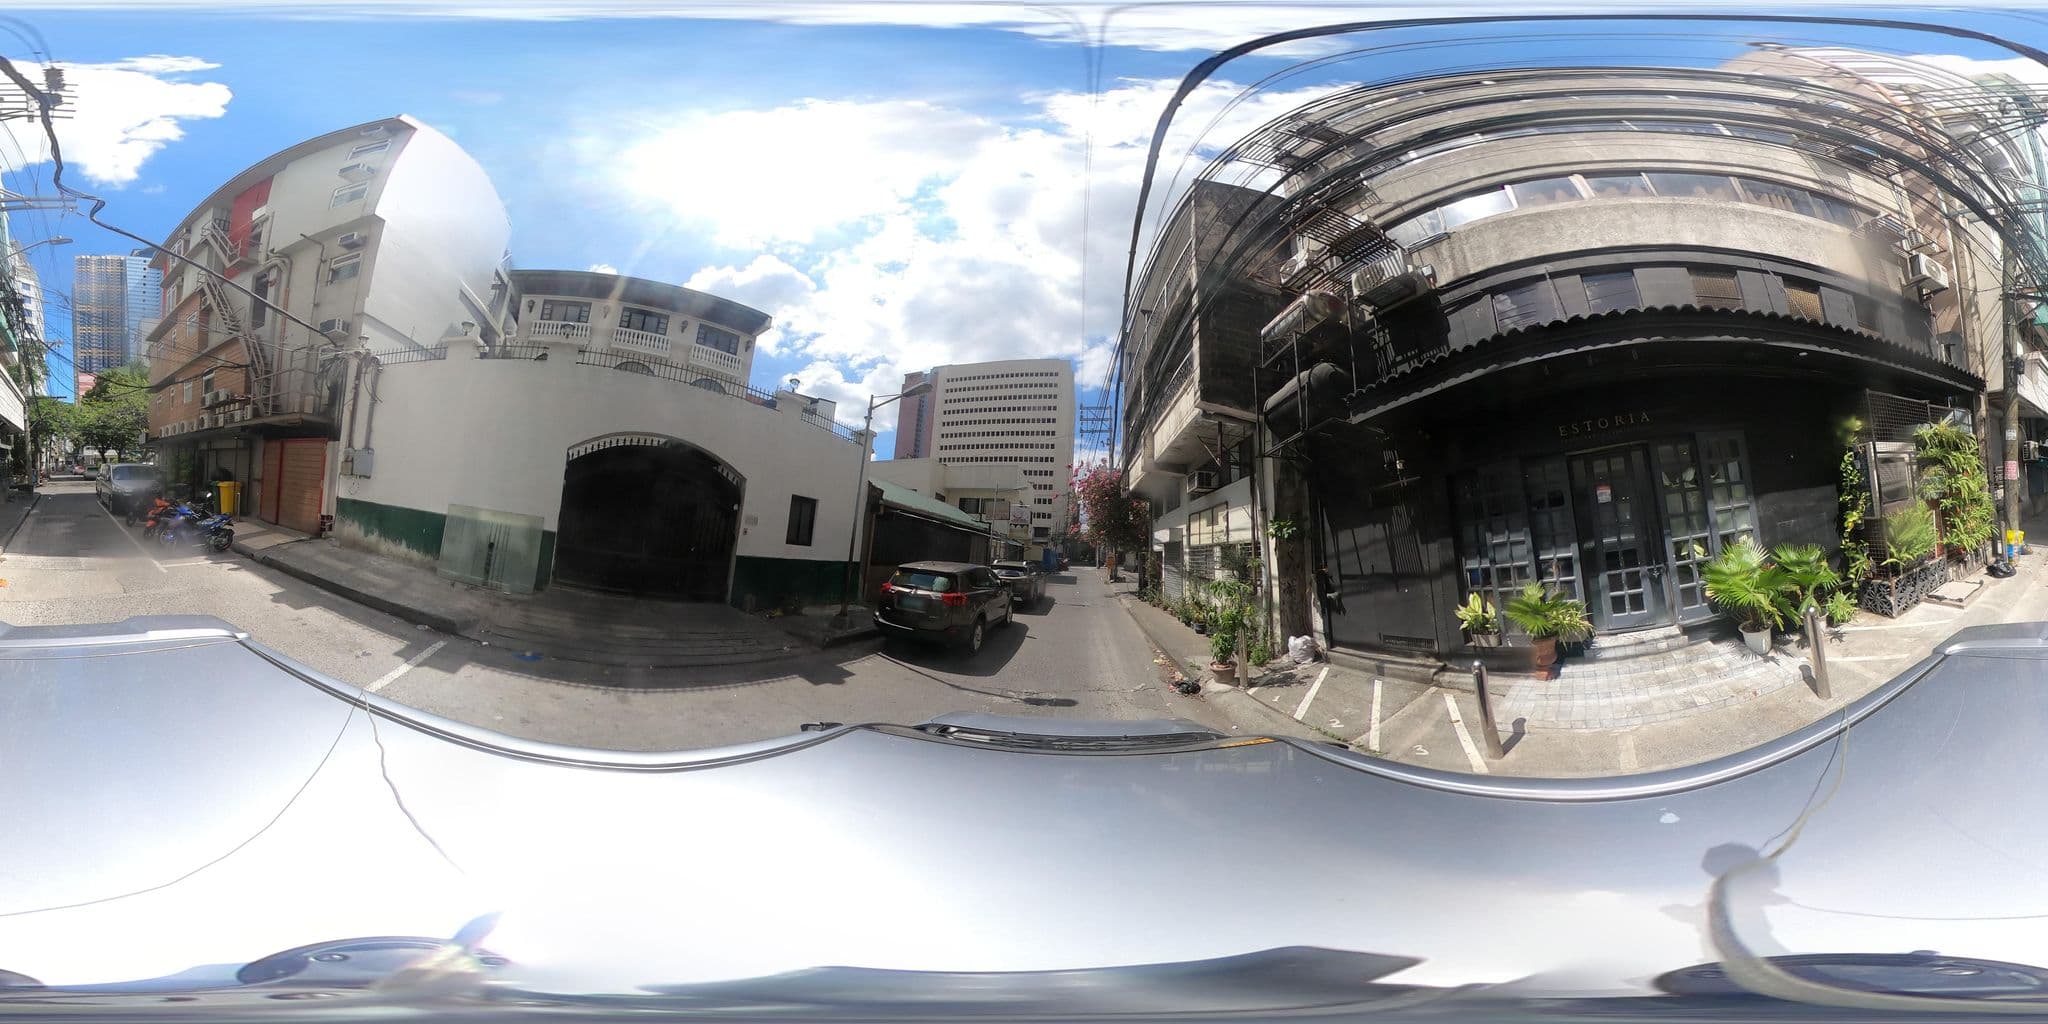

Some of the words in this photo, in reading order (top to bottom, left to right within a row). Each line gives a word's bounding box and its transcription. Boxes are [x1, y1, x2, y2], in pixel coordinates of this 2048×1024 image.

[1558, 411, 1651, 437] ESTORIA
[1328, 718, 1345, 728] 2
[1413, 744, 1430, 756] 3
